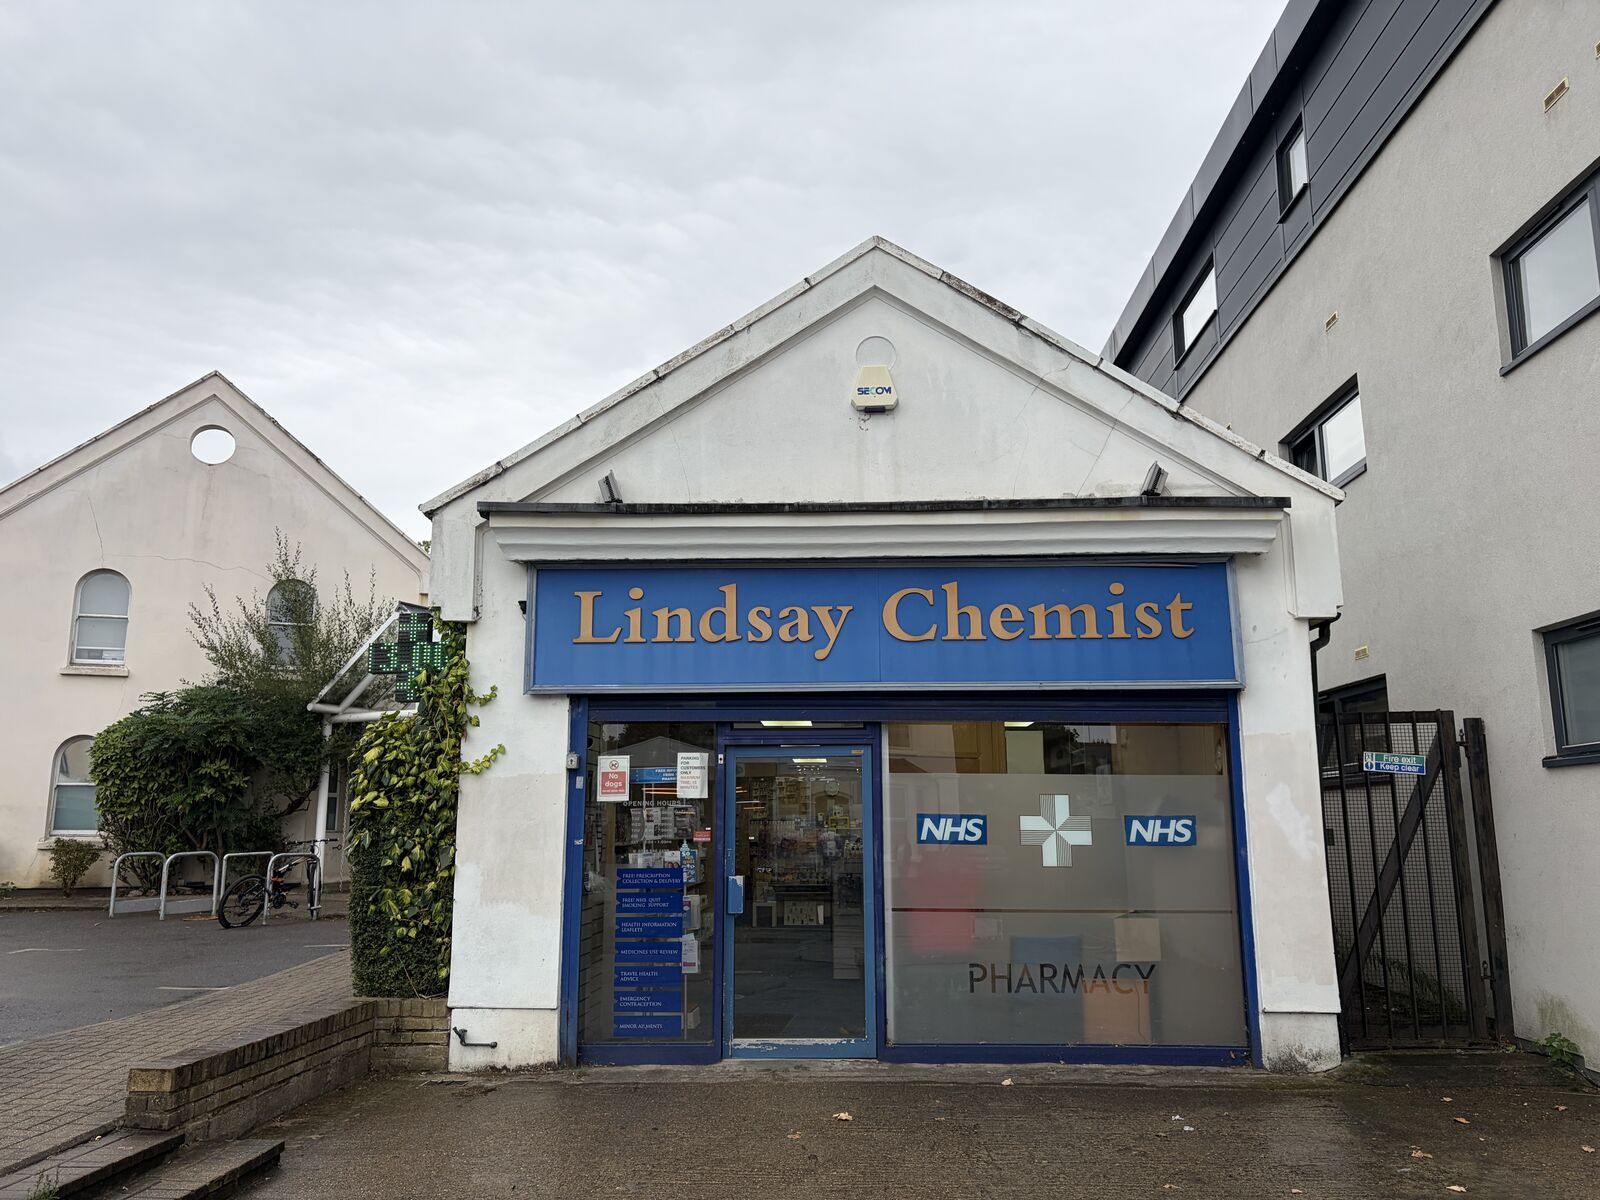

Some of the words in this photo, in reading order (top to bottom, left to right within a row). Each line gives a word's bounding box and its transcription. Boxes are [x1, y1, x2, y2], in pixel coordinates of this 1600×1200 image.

[857, 386, 892, 396] SECOM
[572, 583, 854, 661] Lindsay
[881, 580, 1195, 643] Chemist
[1379, 763, 1399, 771] Keep
[1401, 764, 1420, 772] clear
[1383, 754, 1399, 763] Fire
[1401, 756, 1416, 764] exit
[604, 780, 623, 788] dogs
[920, 817, 984, 842] NHS
[1129, 818, 1193, 843] NHS
[968, 963, 1158, 994] PHARMACY
